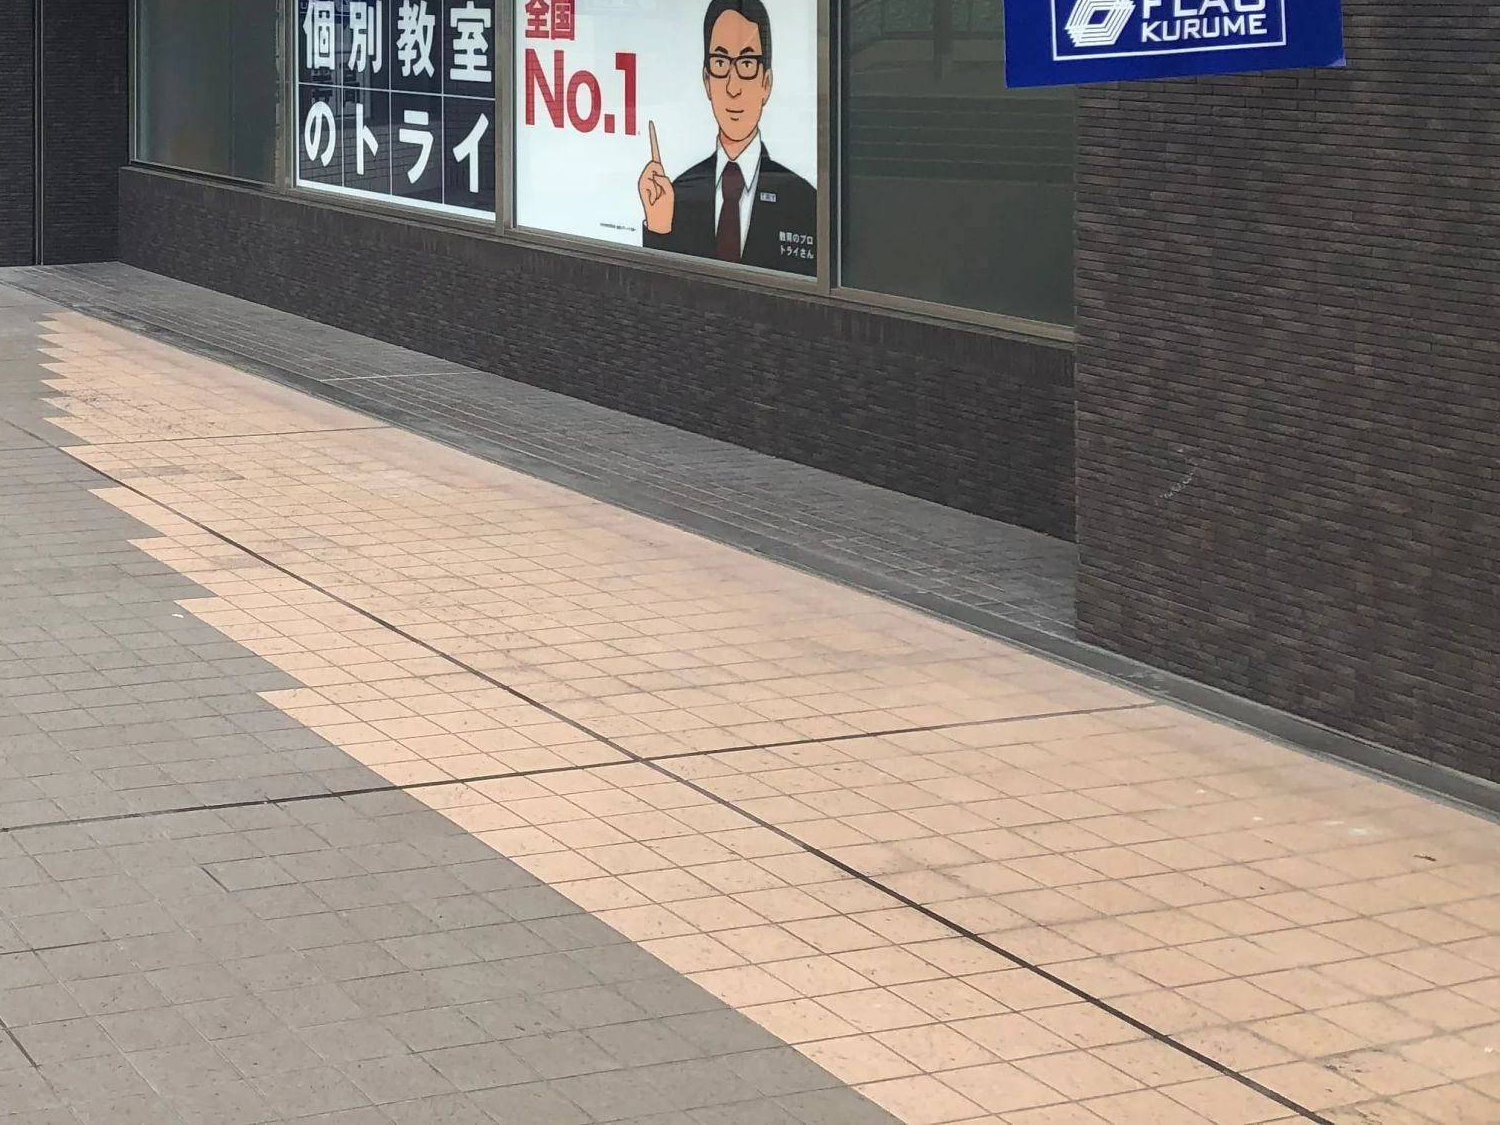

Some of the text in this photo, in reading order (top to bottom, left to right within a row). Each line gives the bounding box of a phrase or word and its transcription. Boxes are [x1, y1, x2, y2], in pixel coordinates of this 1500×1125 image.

[302, 0, 492, 82] 個別教室
[1141, 14, 1268, 43] KURUME
[525, 48, 637, 135] No.1
[304, 101, 490, 193] のトライ
[780, 245, 814, 259] トライさん
